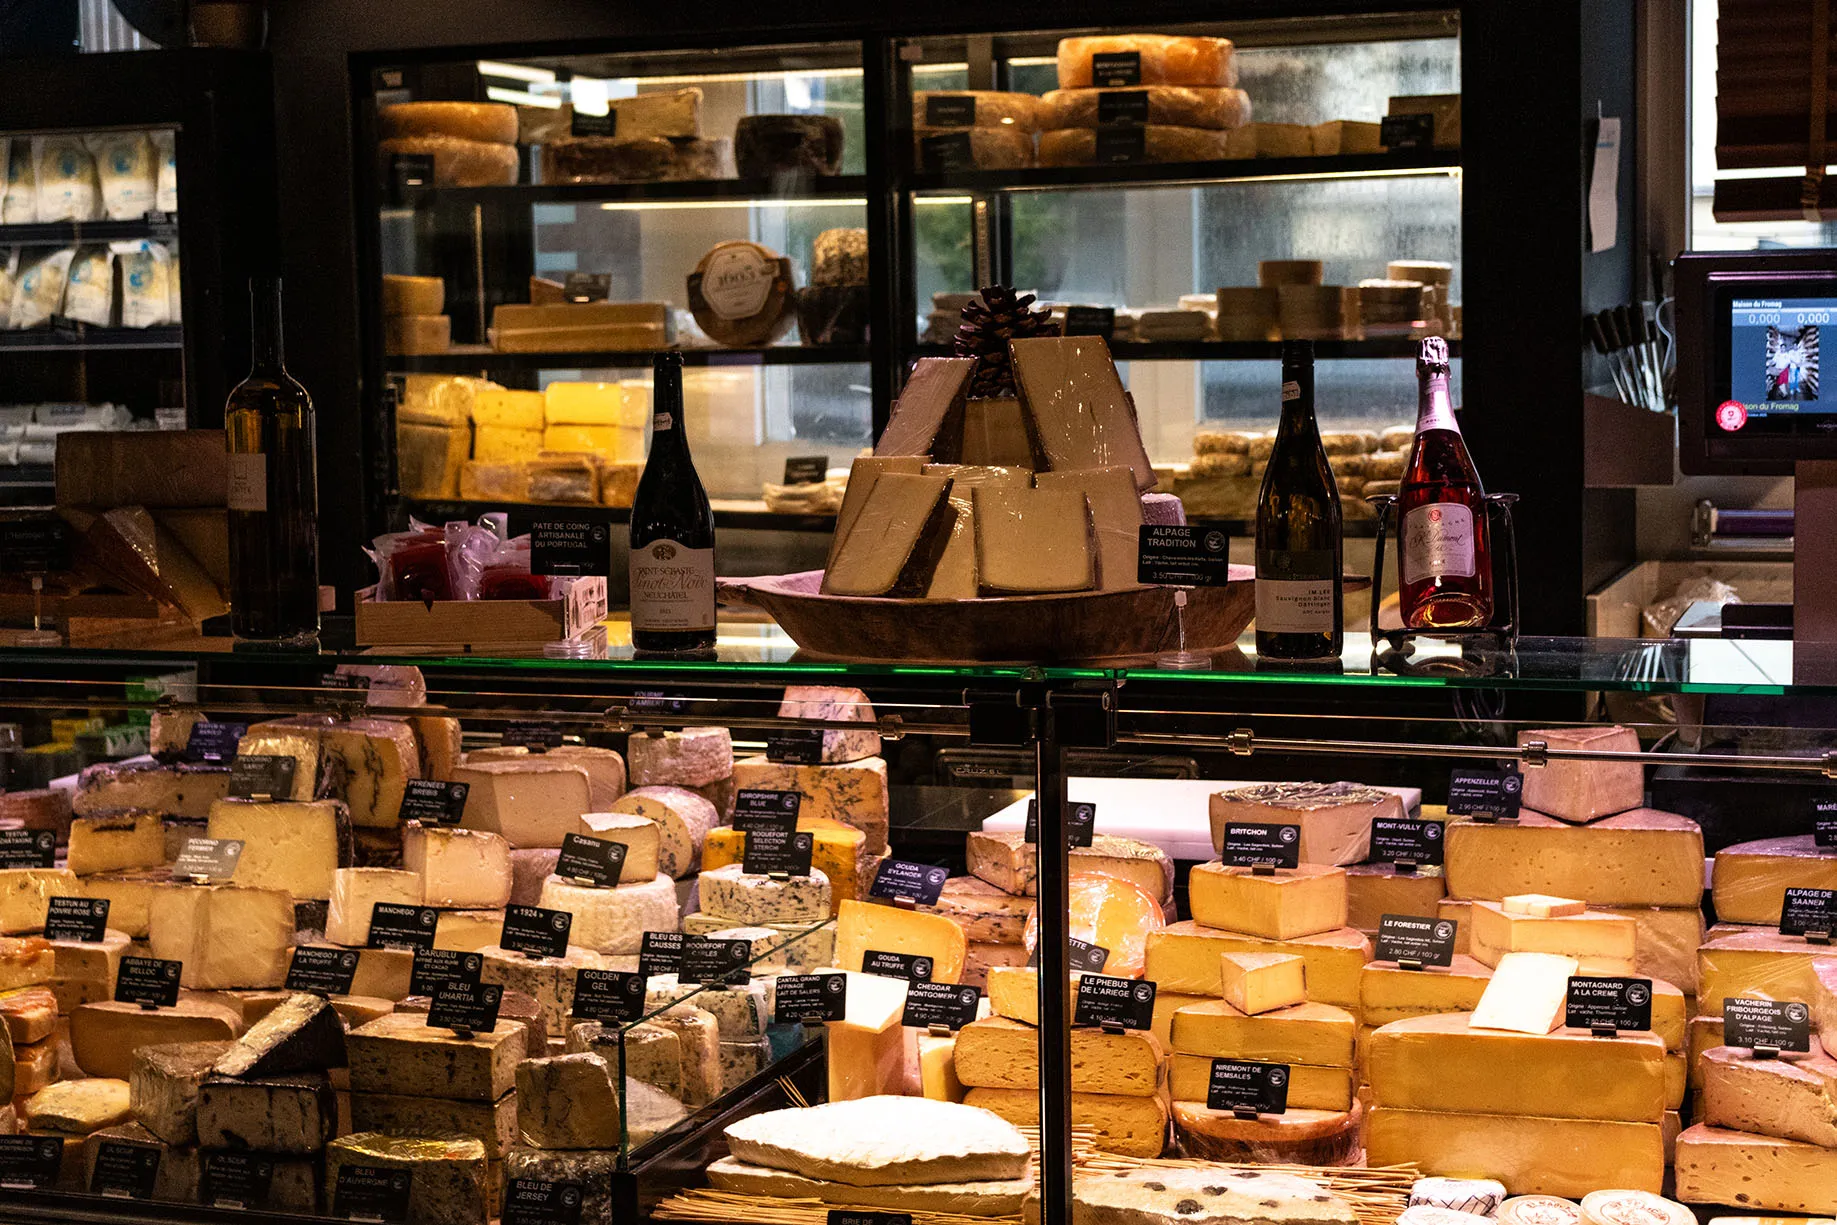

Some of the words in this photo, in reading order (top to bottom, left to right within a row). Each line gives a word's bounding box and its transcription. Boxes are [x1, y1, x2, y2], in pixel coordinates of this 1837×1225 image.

[1761, 301, 1782, 309] Fromag
[1748, 314, 1780, 324] 0,000
[1797, 313, 1829, 324] 0,000
[1770, 402, 1799, 411] Fromag
[538, 532, 585, 540] ARTISANALE
[1152, 528, 1190, 537] ALPAGE
[1147, 538, 1196, 548] TRADITION
[1454, 778, 1500, 786] APPENZELLER
[740, 792, 779, 800] SHROPSHIRE
[1376, 822, 1421, 830] MONT-VULLY
[1230, 828, 1268, 836] BRITCHON
[573, 836, 600, 848] Casanu
[895, 862, 920, 872] GOUDA
[1786, 889, 1820, 898] ALPAGE
[1791, 898, 1825, 906] SAANEN
[378, 906, 416, 916] MANCHEGO
[520, 908, 538, 918] 1924
[1393, 921, 1431, 930] FORESTIER
[650, 932, 668, 940] BLEU
[668, 934, 682, 942] DES
[649, 941, 681, 950] CAUSSES
[686, 942, 726, 950] ROQUEFORT
[878, 954, 900, 962] GOUDA
[882, 962, 905, 970] TRUFFE
[584, 971, 620, 982] GOLDEN
[448, 982, 471, 992] BLEU
[591, 982, 608, 991] GEL
[917, 982, 951, 991] CHEDDAR
[1084, 977, 1095, 985] LE
[1096, 978, 1128, 989] PHEBUS
[1571, 981, 1623, 990] MONTAGNARD
[908, 990, 958, 1000] MONTGOMERY
[1080, 986, 1091, 994] DE
[1092, 987, 1130, 998] L'ARIEGE
[1734, 998, 1772, 1008] VACHERIN
[1726, 1005, 1782, 1016] FRIBOURGEOIS
[1735, 1014, 1772, 1022] D'ALPAGE
[1215, 1064, 1250, 1073] NIREMONT
[1250, 1066, 1262, 1074] DE
[1215, 1071, 1251, 1080] SEMSALES
[354, 1168, 376, 1176] BLEU
[339, 1176, 389, 1188] D'AUVERGNE
[516, 1180, 539, 1190] BLEU
[540, 1183, 553, 1192] DE
[516, 1191, 549, 1202] JERSEY
